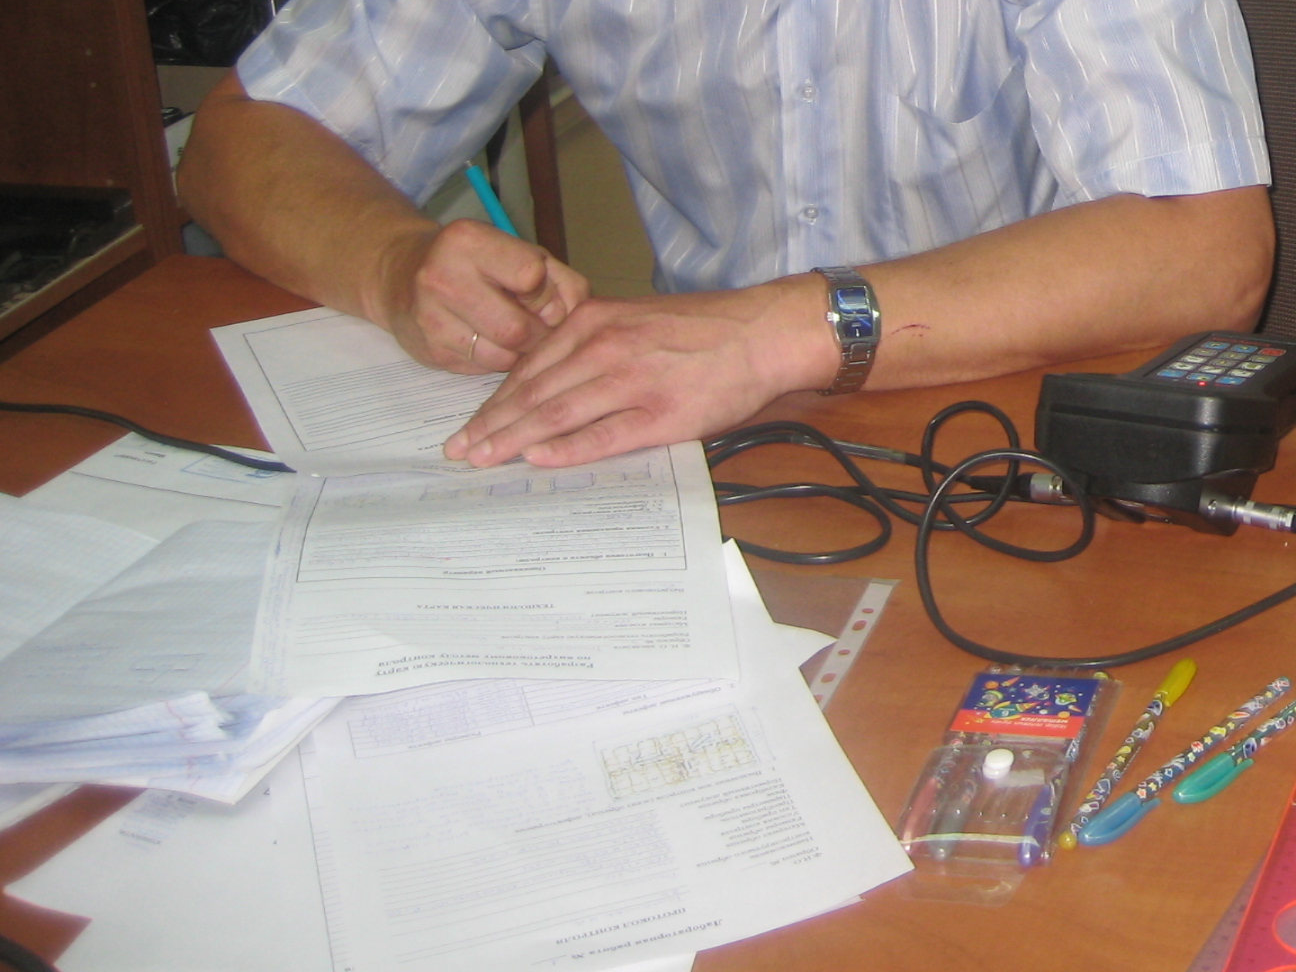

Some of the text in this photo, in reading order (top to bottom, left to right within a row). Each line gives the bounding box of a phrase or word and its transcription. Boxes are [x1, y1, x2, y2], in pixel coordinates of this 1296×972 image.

[374, 660, 594, 677] Разработать технологическую карту
[378, 653, 436, 668] контроля
[555, 907, 686, 946] ПРОТОКОЛ КОНТРОЛЯ
[635, 919, 723, 946] Лабораторная
[588, 940, 631, 958] работа
